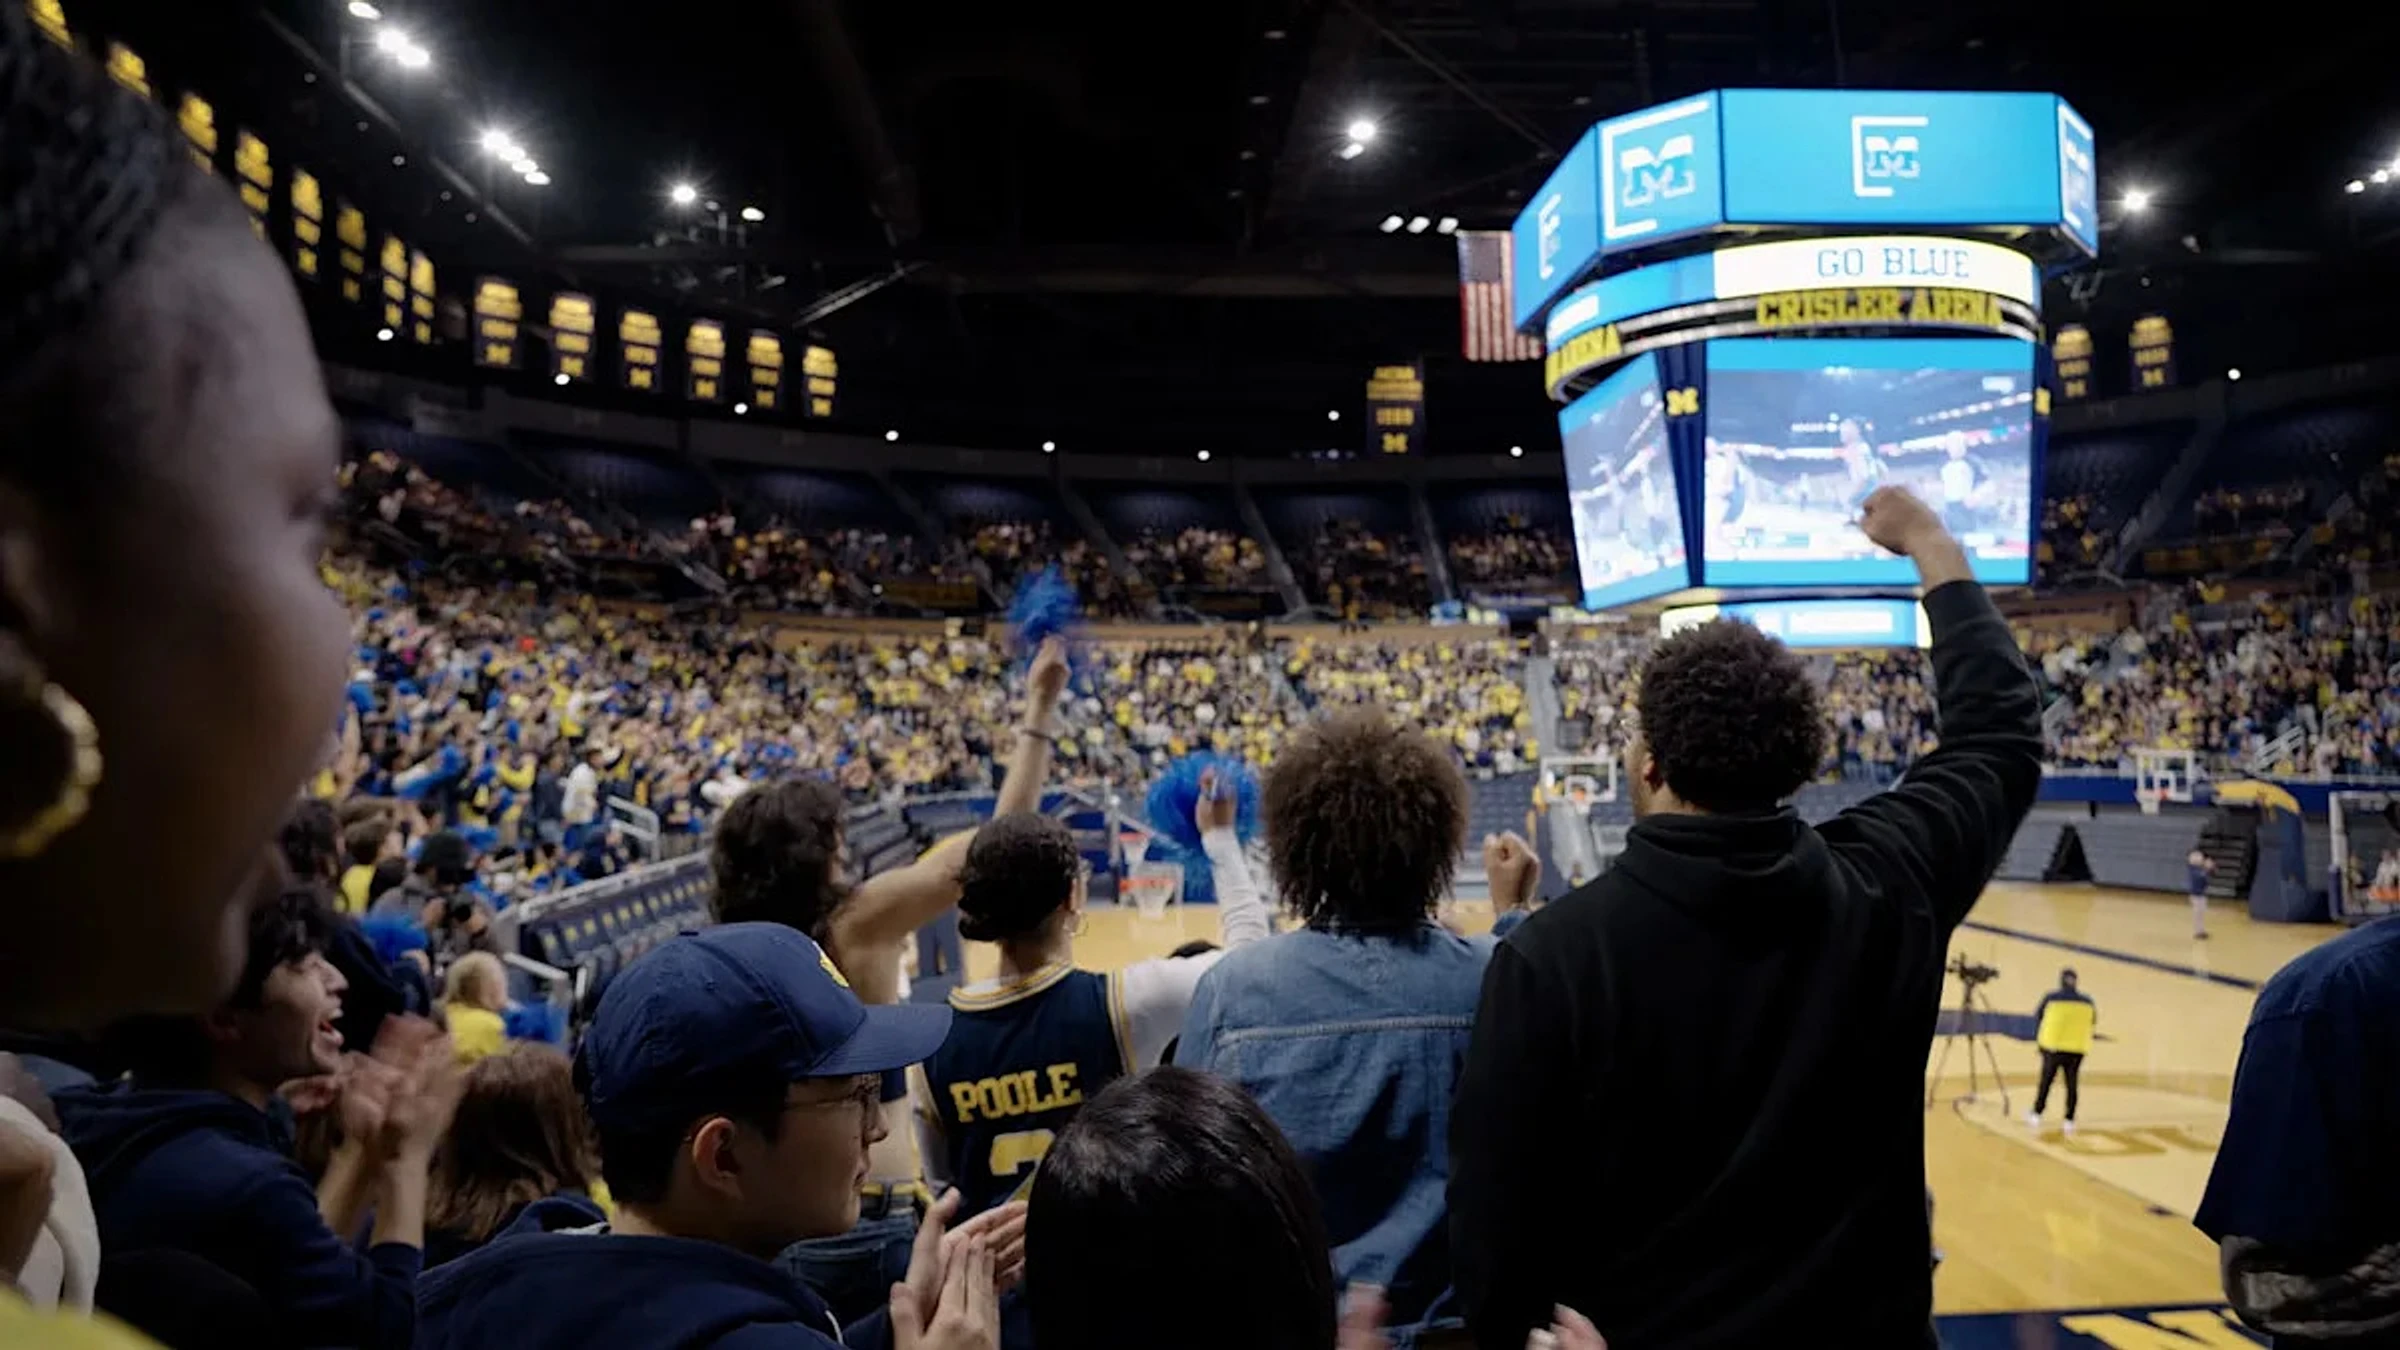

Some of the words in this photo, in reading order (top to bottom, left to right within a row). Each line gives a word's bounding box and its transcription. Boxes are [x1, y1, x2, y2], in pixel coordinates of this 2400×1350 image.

[1620, 134, 1695, 207] M
[1865, 136, 1920, 178] M
[1816, 249, 1863, 279] GO
[1883, 246, 1969, 278] BLUE
[1756, 286, 1900, 327] CRISLER
[1908, 287, 2003, 327] ARENA
[1666, 377, 1699, 416] M
[949, 1062, 1083, 1123] POOLE
